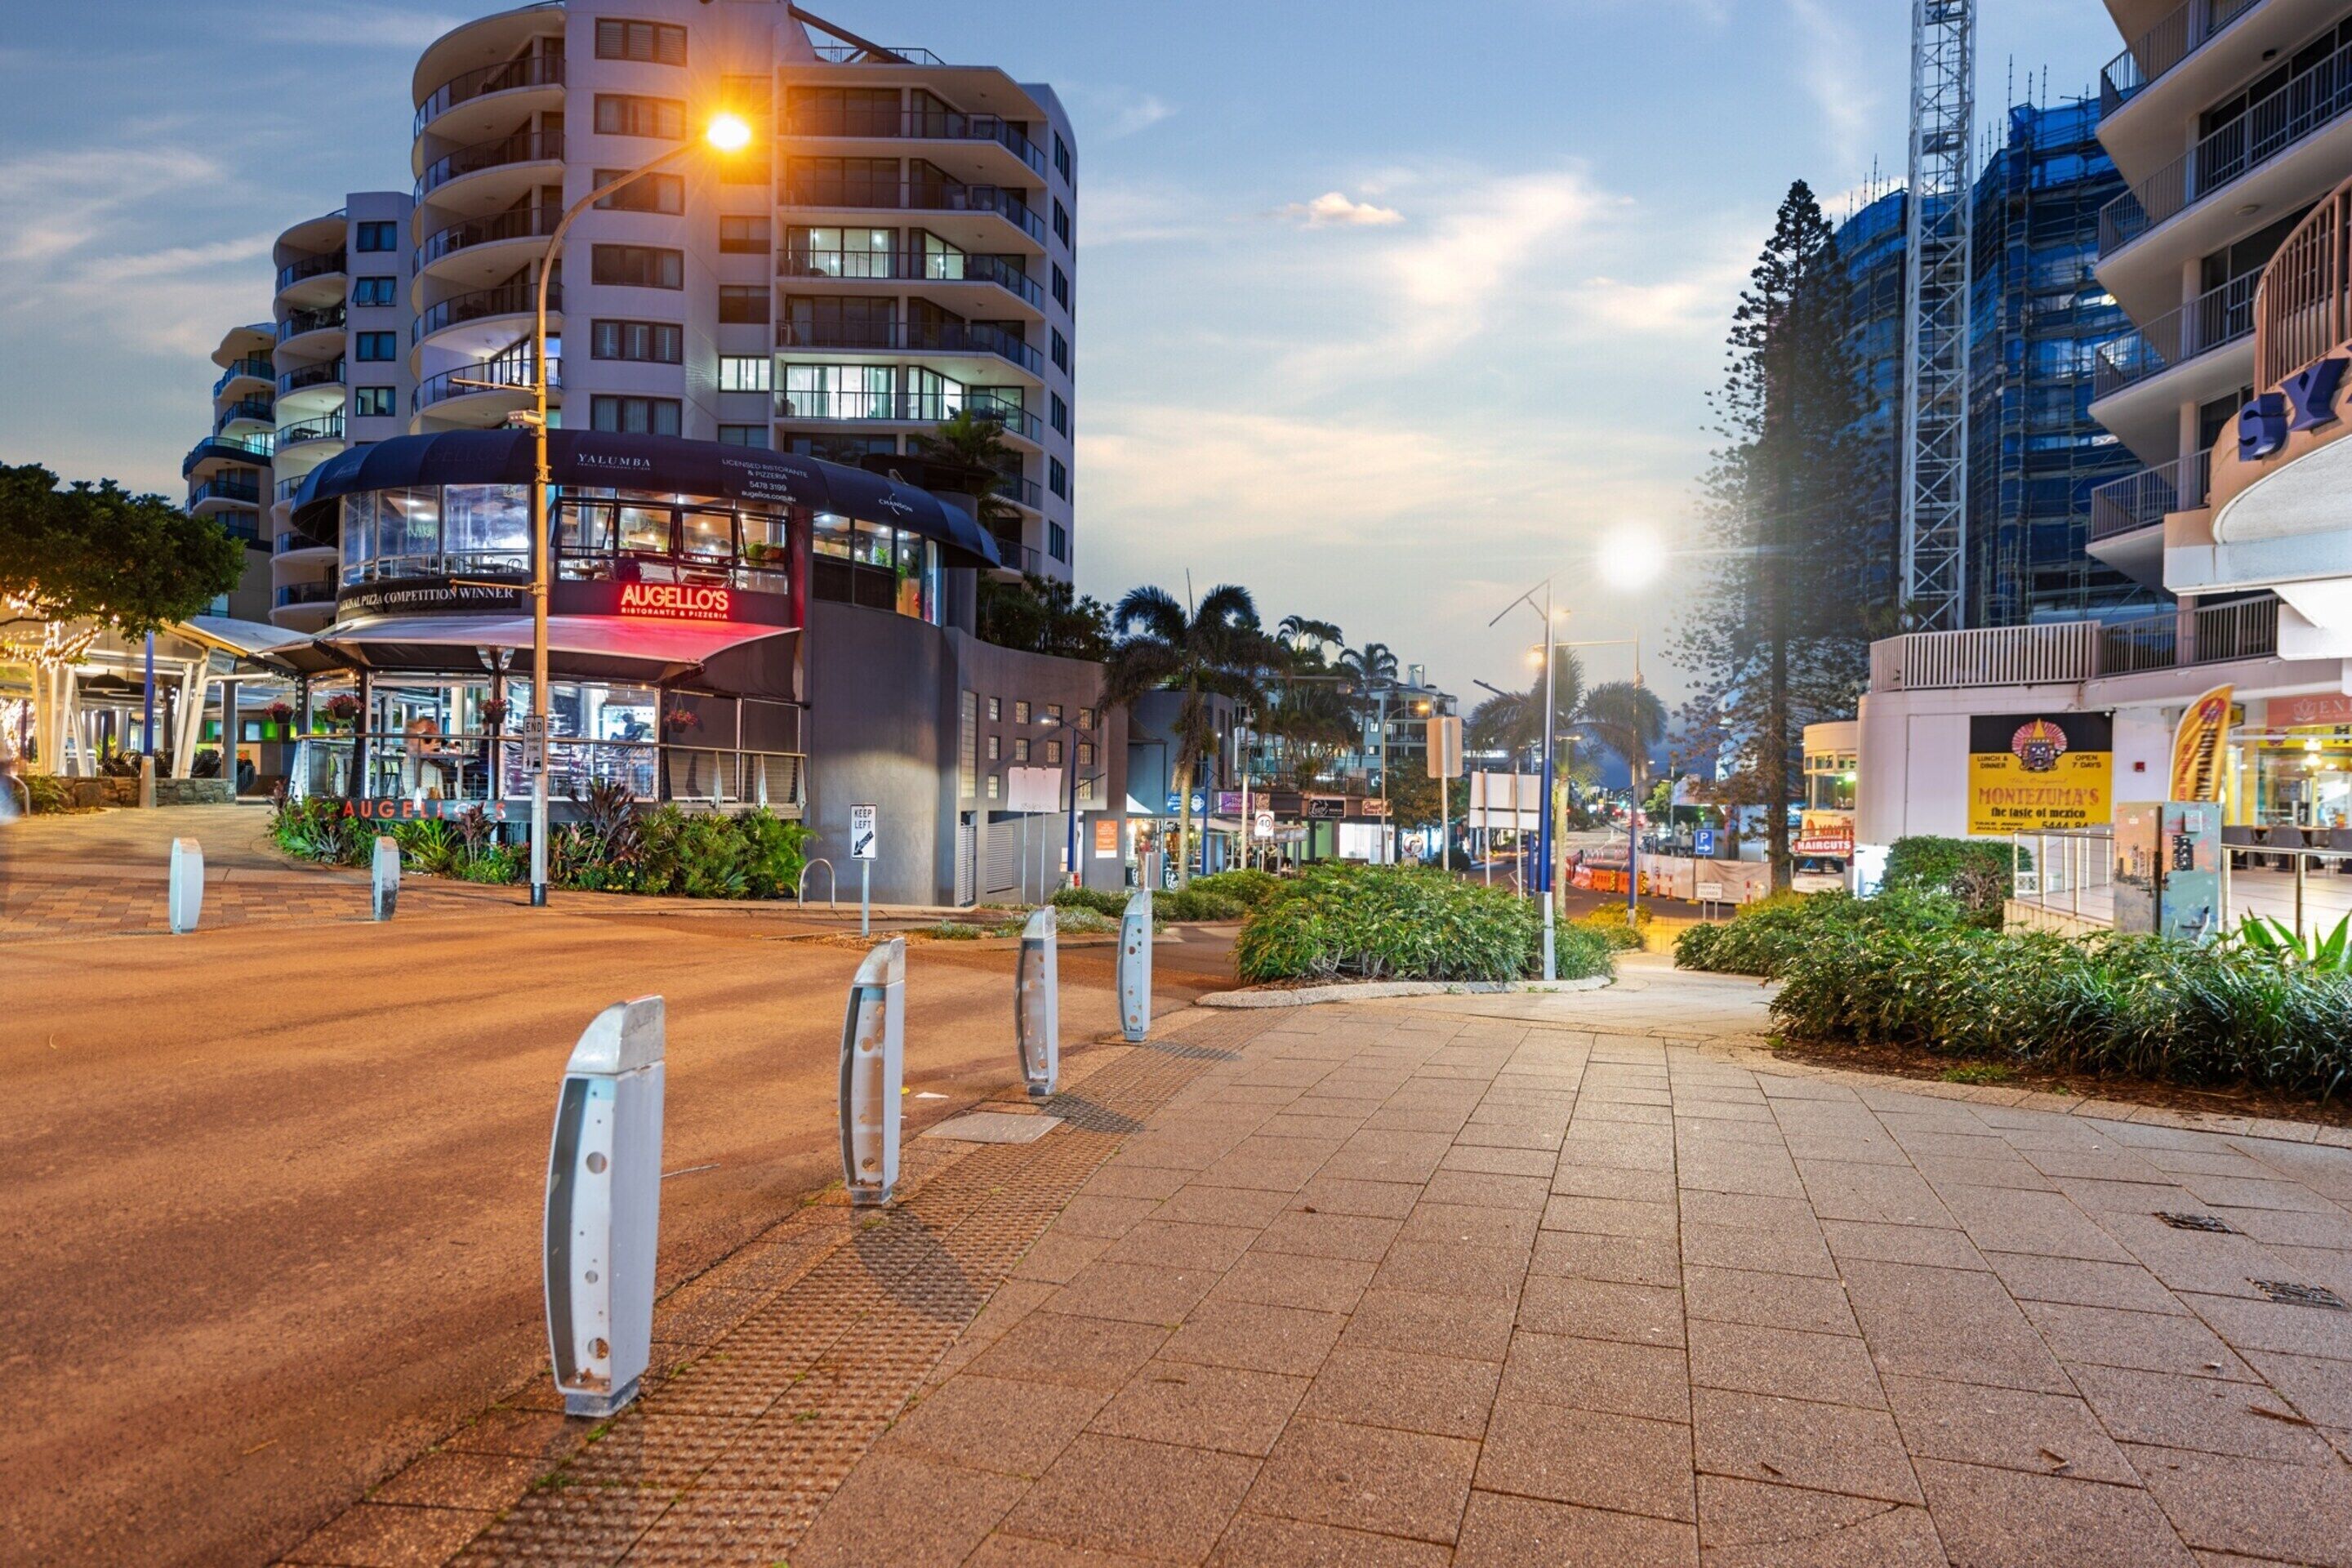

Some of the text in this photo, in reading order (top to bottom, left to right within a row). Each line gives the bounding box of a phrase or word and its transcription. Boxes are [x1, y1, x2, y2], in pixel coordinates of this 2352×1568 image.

[2238, 344, 2352, 461] SY
[577, 453, 651, 467] YALUMBA
[722, 458, 808, 479] LICENSED RISTORANTE
[756, 471, 787, 479] PIZZERIA
[750, 481, 787, 492] 5478 3199
[742, 491, 796, 502] augellos.com.au
[361, 594, 383, 606] PIZZA
[384, 587, 457, 604] COMPETITION
[460, 587, 514, 599] WINNER
[621, 585, 729, 611] AUGELLO'S
[621, 607, 675, 617] RISTORANTE
[688, 611, 728, 619] PIZZERIA
[2320, 699, 2352, 713] EN
[526, 722, 542, 733] END
[1979, 787, 2099, 805] MONTEZUMA'S
[854, 809, 872, 817] KEEP
[1991, 807, 2086, 818] the taste of mexico
[854, 821, 871, 829] LEFT
[1258, 819, 1271, 827] 40
[1699, 832, 1709, 844] P
[1797, 840, 1851, 850] HAIRCUTS
